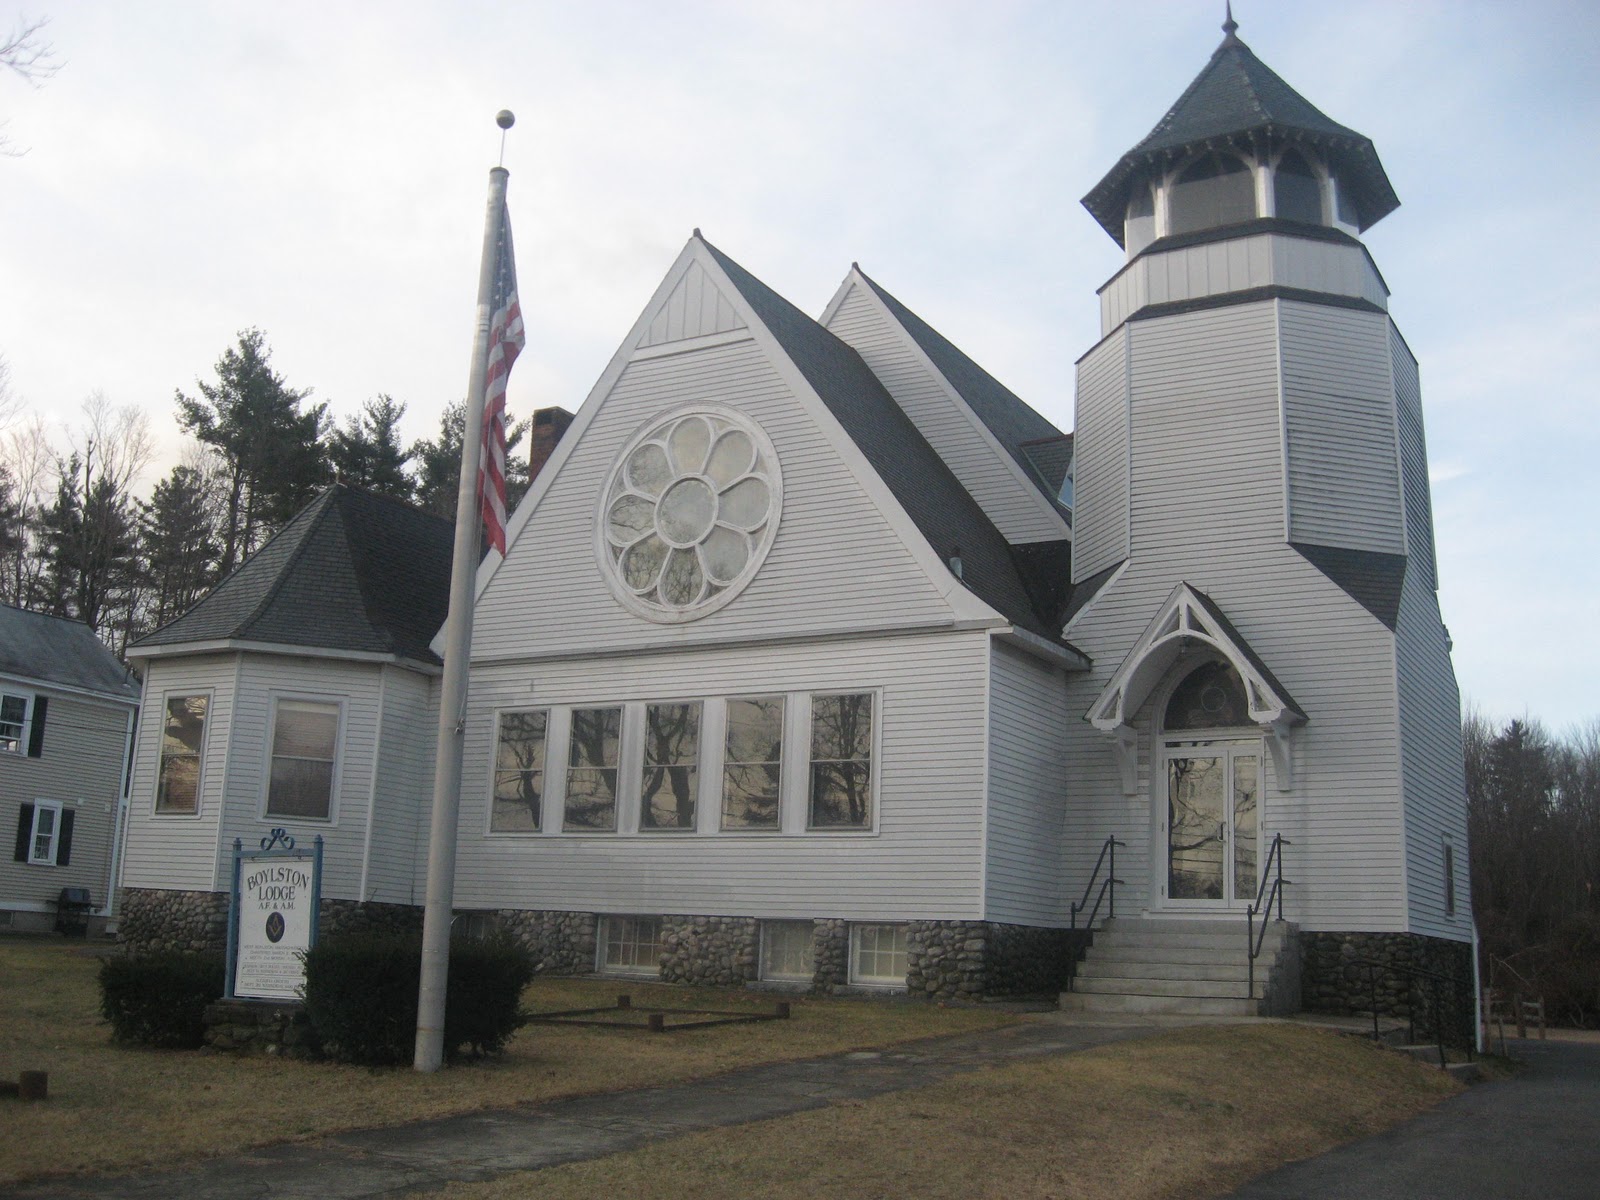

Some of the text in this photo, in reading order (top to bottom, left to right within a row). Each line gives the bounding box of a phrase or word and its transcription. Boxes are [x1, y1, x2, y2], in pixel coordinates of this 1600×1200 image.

[247, 867, 309, 891] BOYLSTON
[258, 886, 295, 901] LODGE
[273, 902, 278, 910] &
